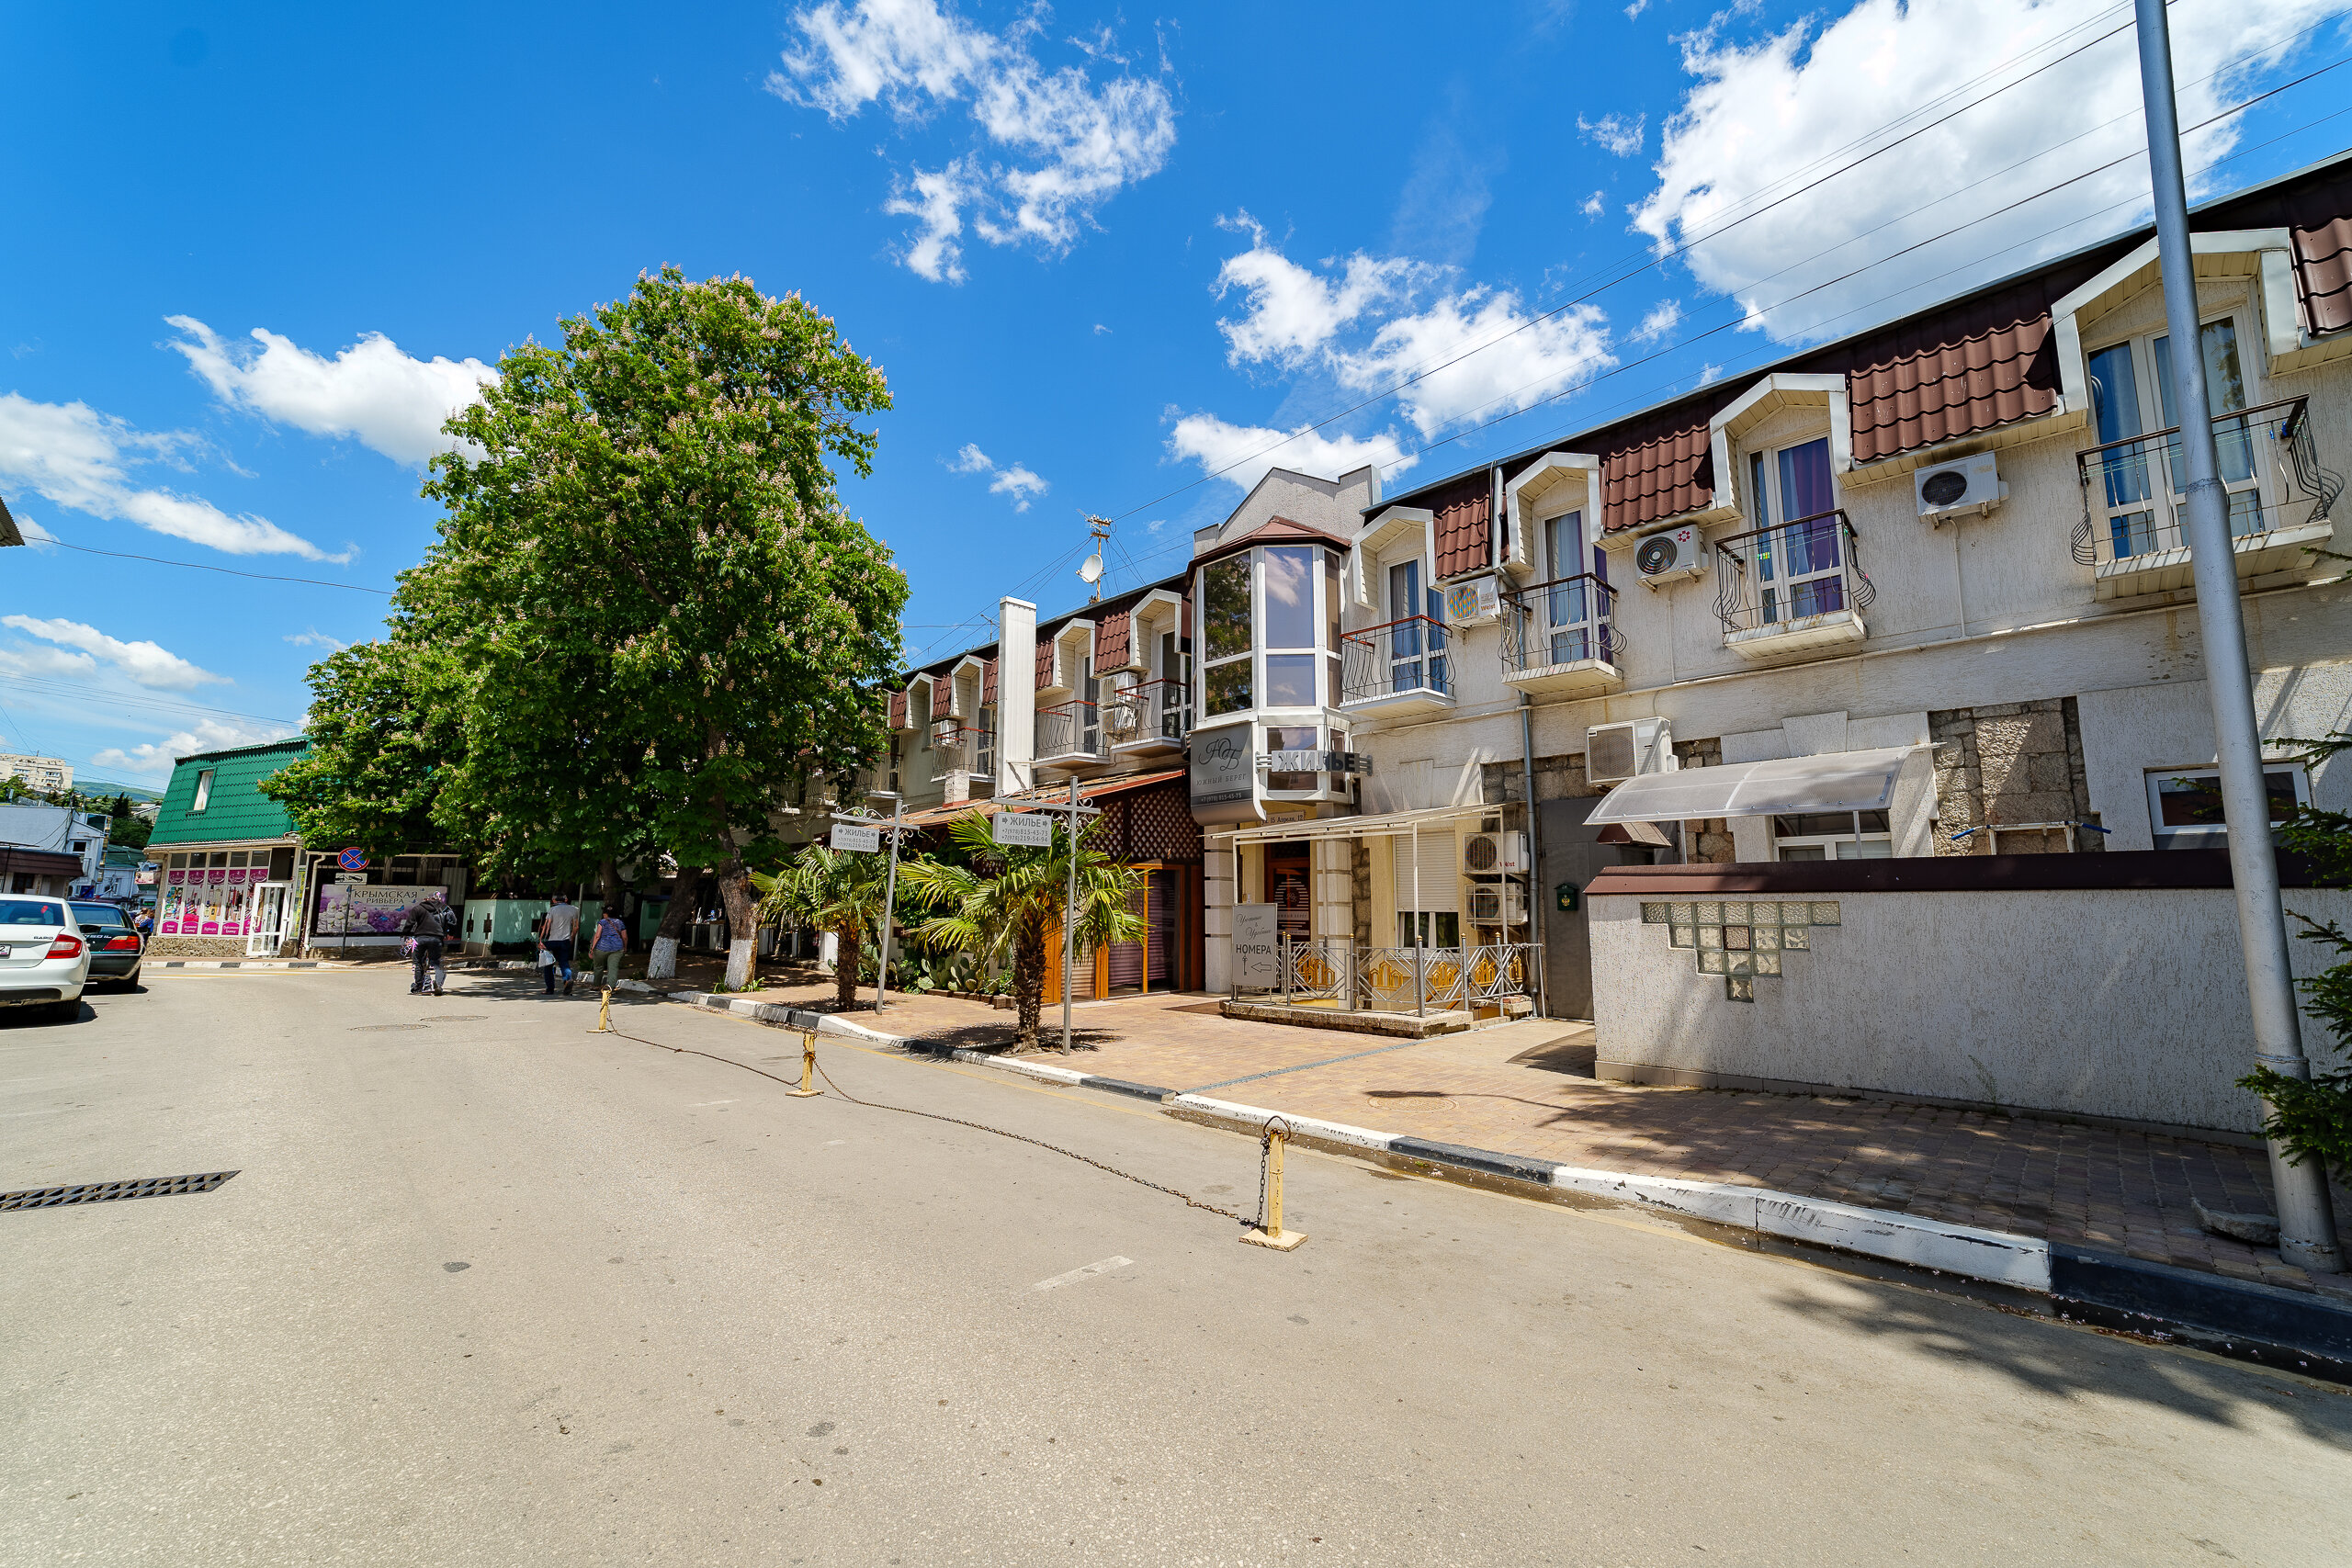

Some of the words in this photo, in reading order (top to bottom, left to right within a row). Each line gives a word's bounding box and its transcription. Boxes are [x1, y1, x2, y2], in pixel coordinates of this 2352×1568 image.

[1278, 750, 1356, 773] ЖИЛЬЕ
[1196, 775, 1222, 785] ЮЖНЫЙ
[1225, 773, 1247, 782] БЕРЕГ
[1010, 817, 1042, 828] ЖИЛЬЕ
[844, 828, 871, 838] ЖИЛЬЕ
[354, 890, 418, 899] КРЫМСКАЯ
[1236, 943, 1272, 955] НОМЕРА
